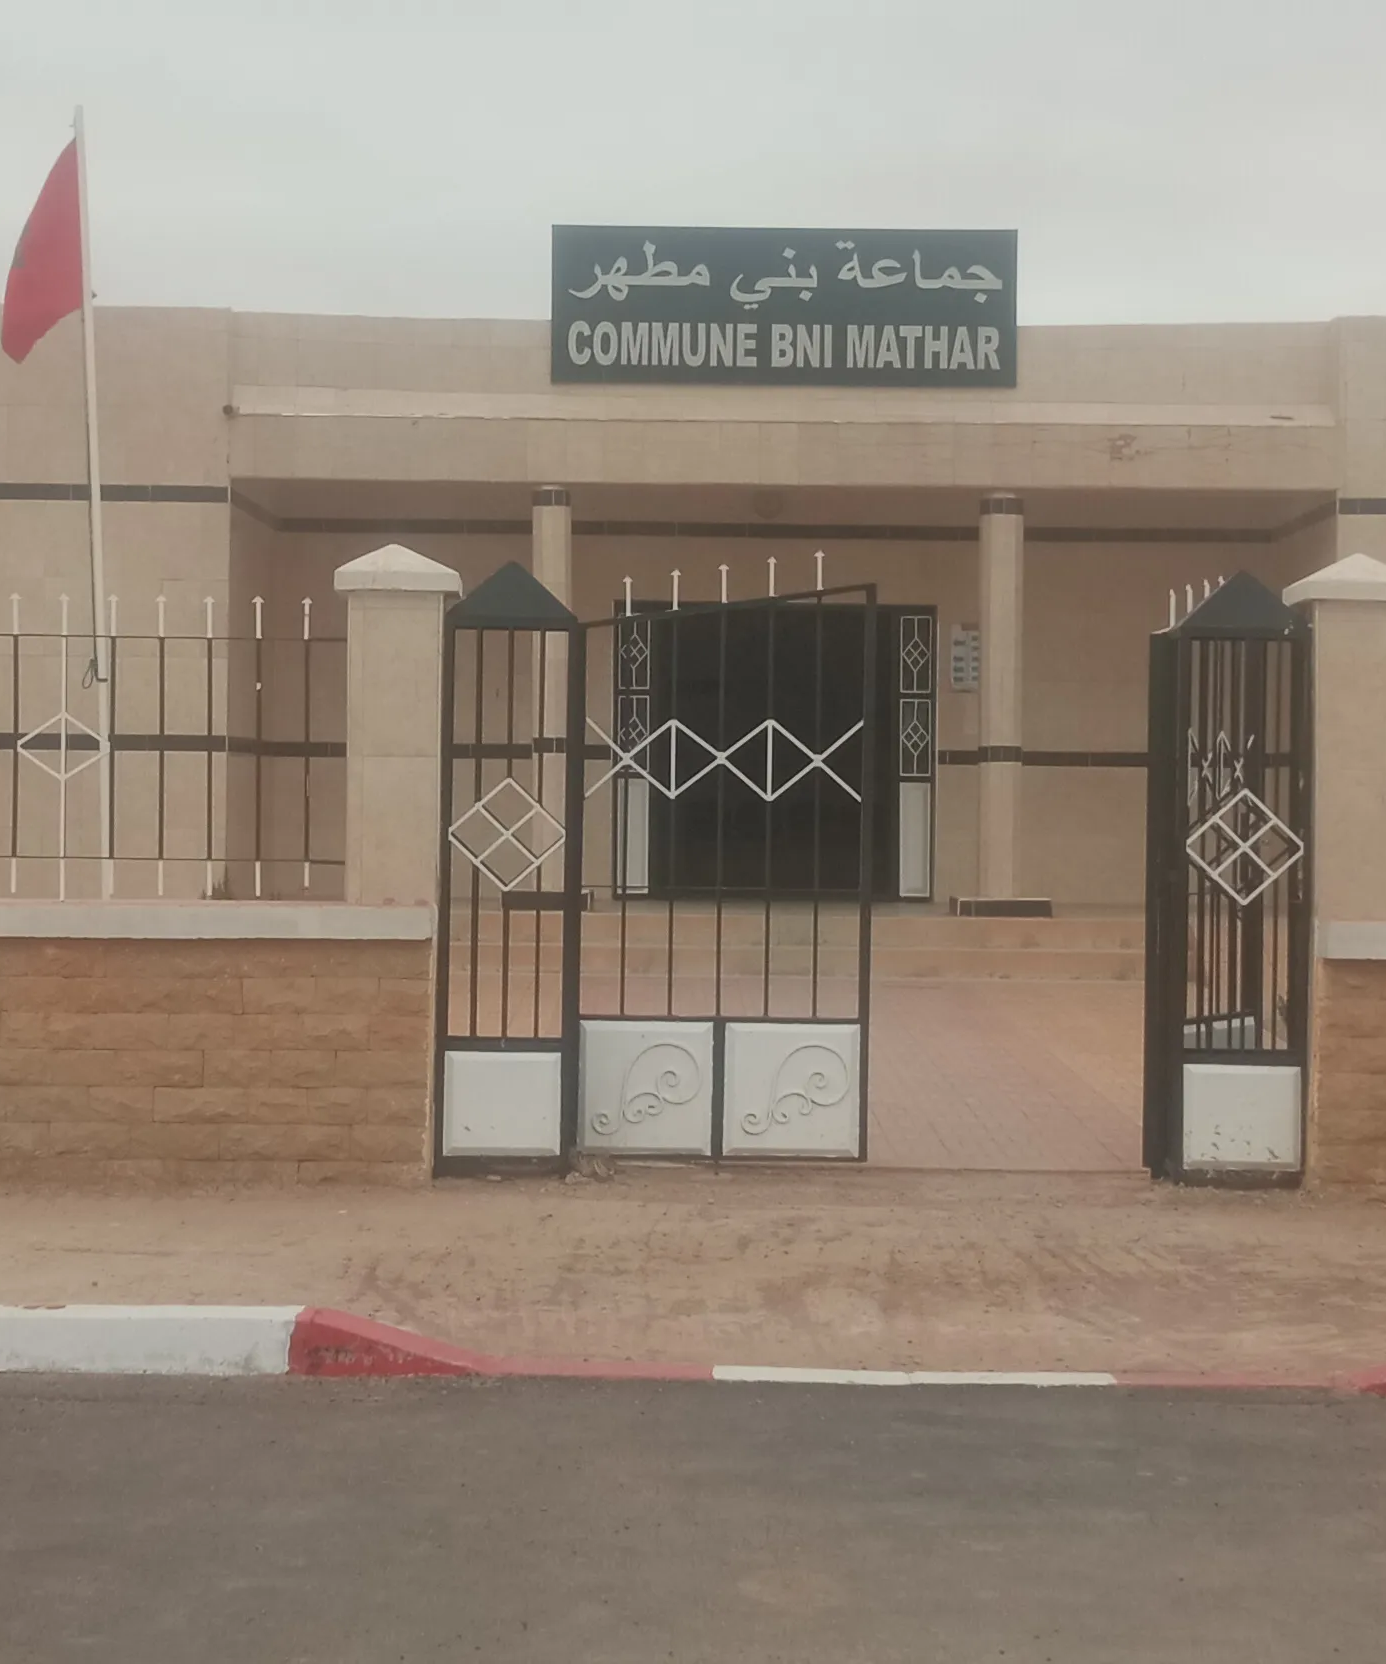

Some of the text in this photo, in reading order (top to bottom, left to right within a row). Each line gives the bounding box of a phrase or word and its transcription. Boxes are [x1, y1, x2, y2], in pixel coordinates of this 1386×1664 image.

[567, 239, 1003, 310] جماعة بني مطهر
[567, 320, 1001, 371] COMMUNE BNI MATHAR
